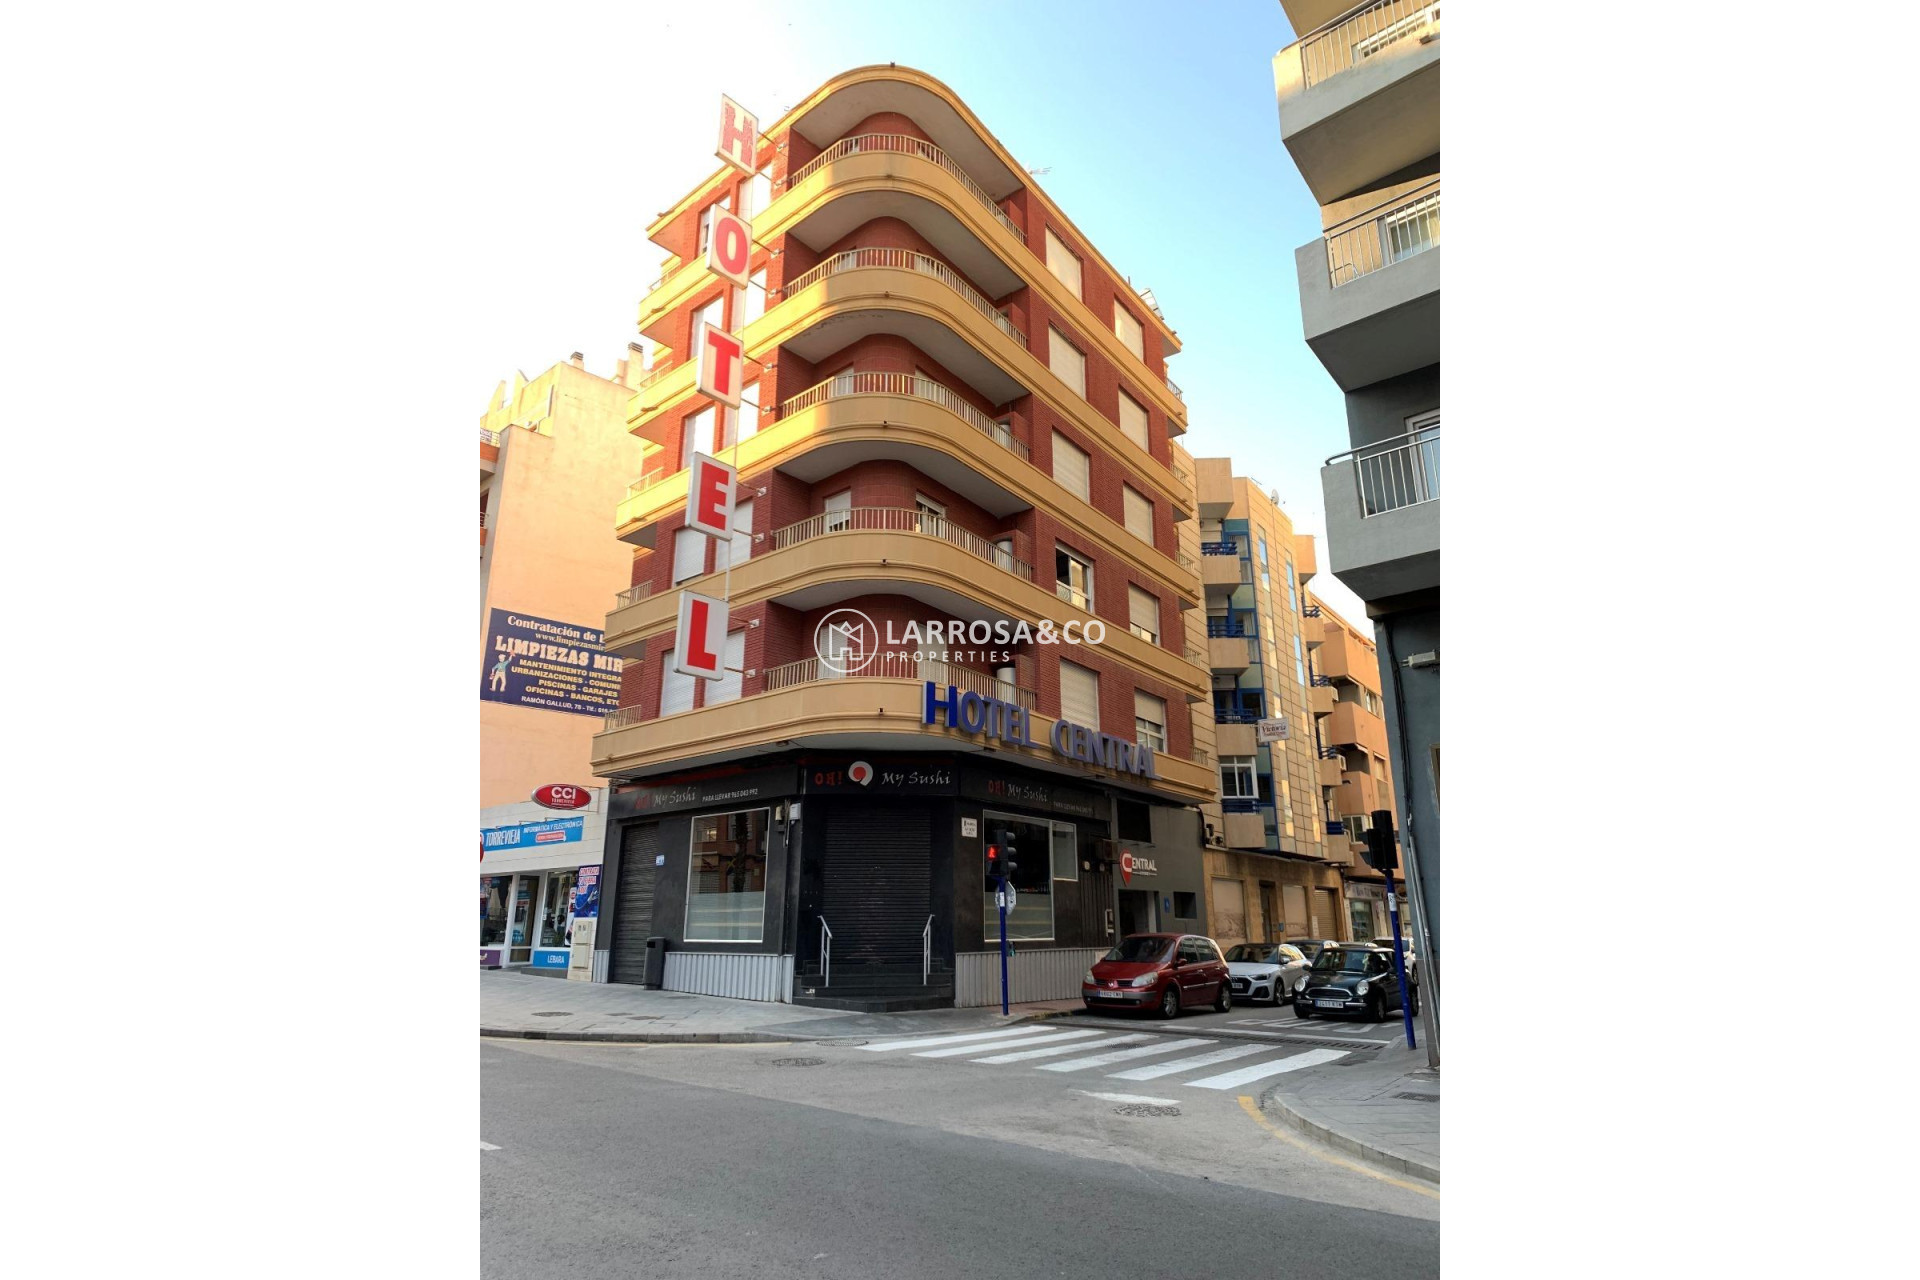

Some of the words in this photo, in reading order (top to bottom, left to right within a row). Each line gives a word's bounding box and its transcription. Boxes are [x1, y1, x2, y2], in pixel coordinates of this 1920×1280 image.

[686, 103, 754, 672] HOTEL
[507, 615, 580, 639] Contratación
[583, 631, 597, 642] de
[495, 635, 589, 667] LIMPIEZAS
[511, 666, 583, 684] URBANIZACIONES
[519, 659, 587, 676] MANTENIMIENTO
[525, 686, 564, 697] OFICINAS
[570, 692, 605, 705] BANCOS,
[539, 679, 577, 691] PISCINAS
[582, 686, 618, 698] GARAJES
[521, 696, 545, 705] RAMÓN
[922, 680, 1040, 749] HOTEL
[1051, 719, 1162, 781] CENTRAL
[881, 771, 904, 787] My
[908, 769, 951, 785] Sushi
[551, 786, 576, 800] CCI
[668, 786, 696, 804] Sushi
[1007, 783, 1022, 799] My
[1023, 785, 1048, 803] Sushi
[485, 828, 520, 847] TORREVIEJA
[1122, 853, 1158, 873] CENTRAL
[547, 955, 564, 964] LEBARA
